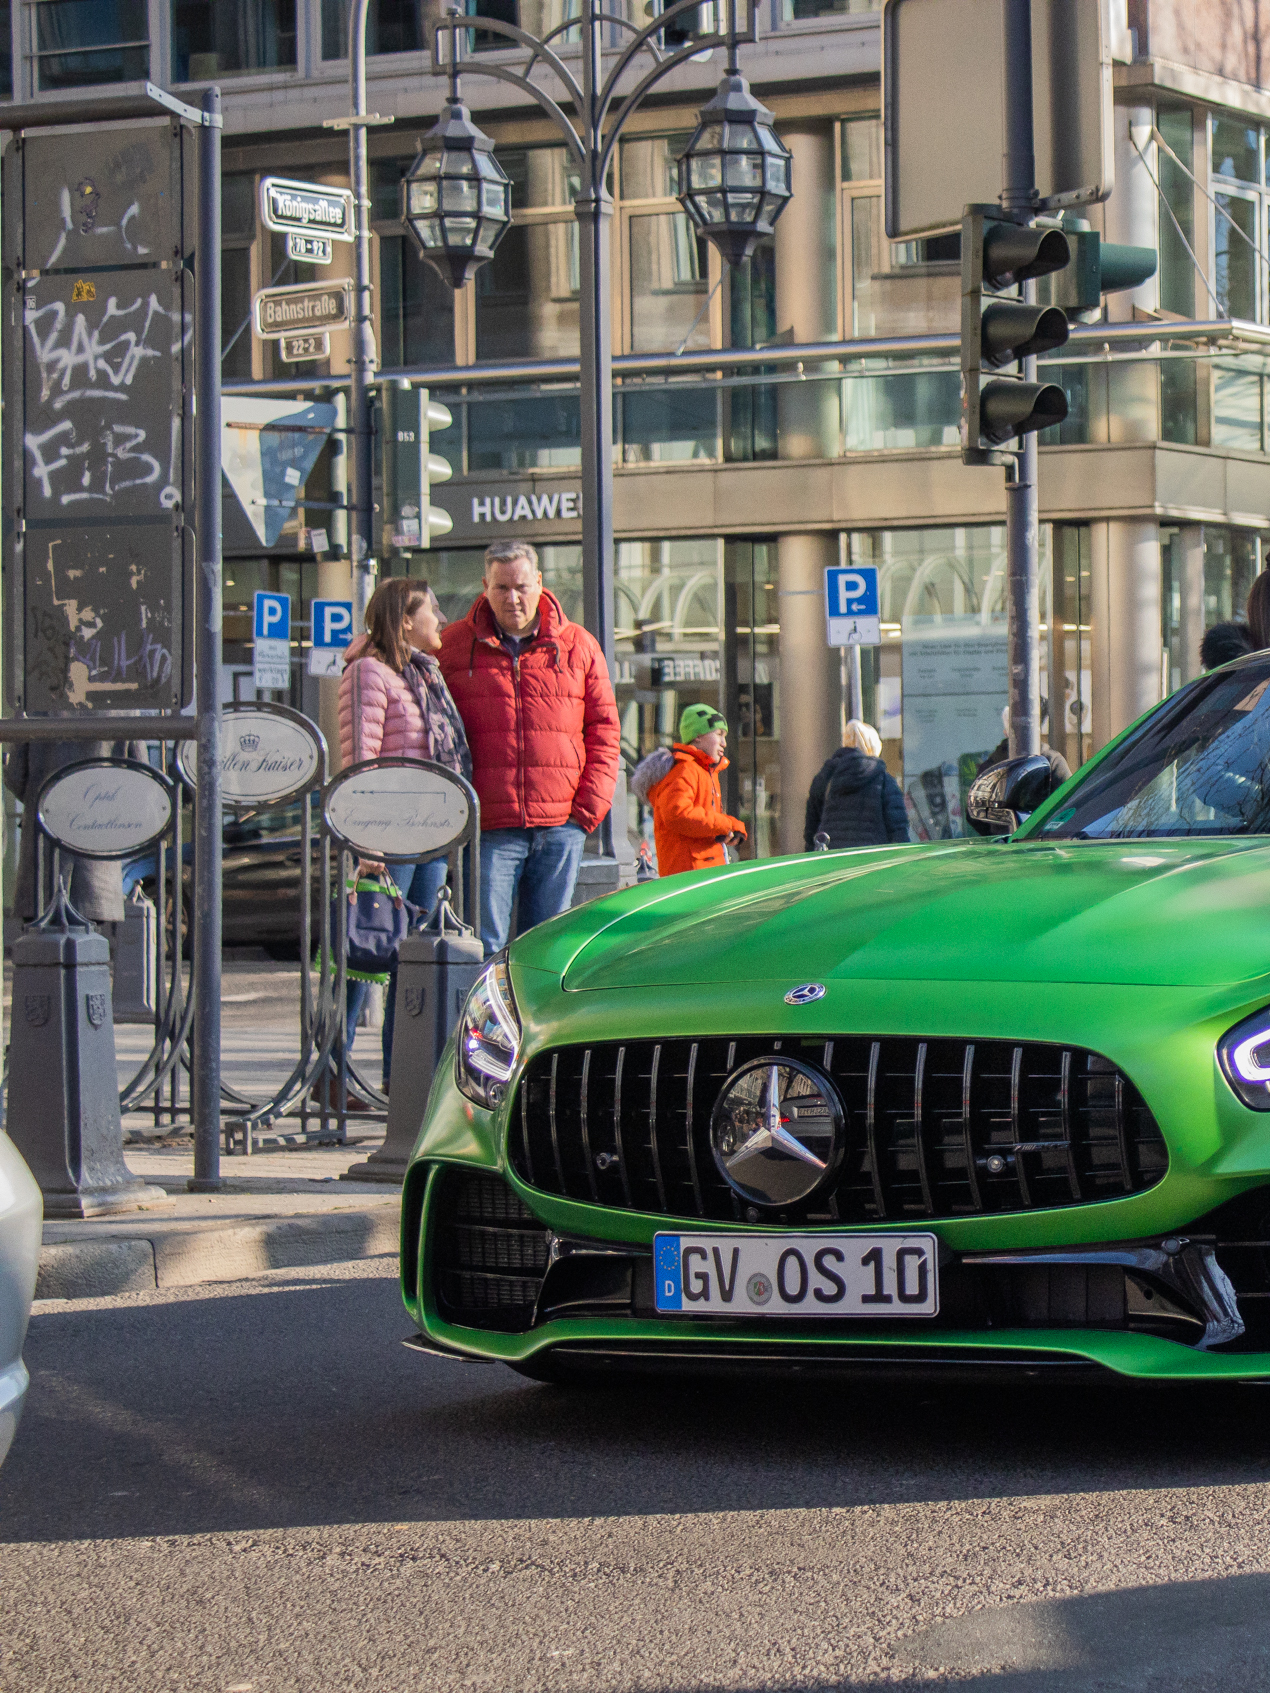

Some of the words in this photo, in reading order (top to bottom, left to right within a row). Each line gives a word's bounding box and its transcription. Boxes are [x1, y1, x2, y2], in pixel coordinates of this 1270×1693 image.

[276, 193, 344, 225] Königsallee
[266, 295, 338, 323] Bahnstraße
[292, 338, 316, 355] 22-2
[838, 573, 867, 615] P
[262, 598, 282, 636] P
[323, 606, 351, 643] P
[252, 749, 306, 773] Kaiser
[664, 1280, 675, 1297] D
[682, 1245, 740, 1303] GV
